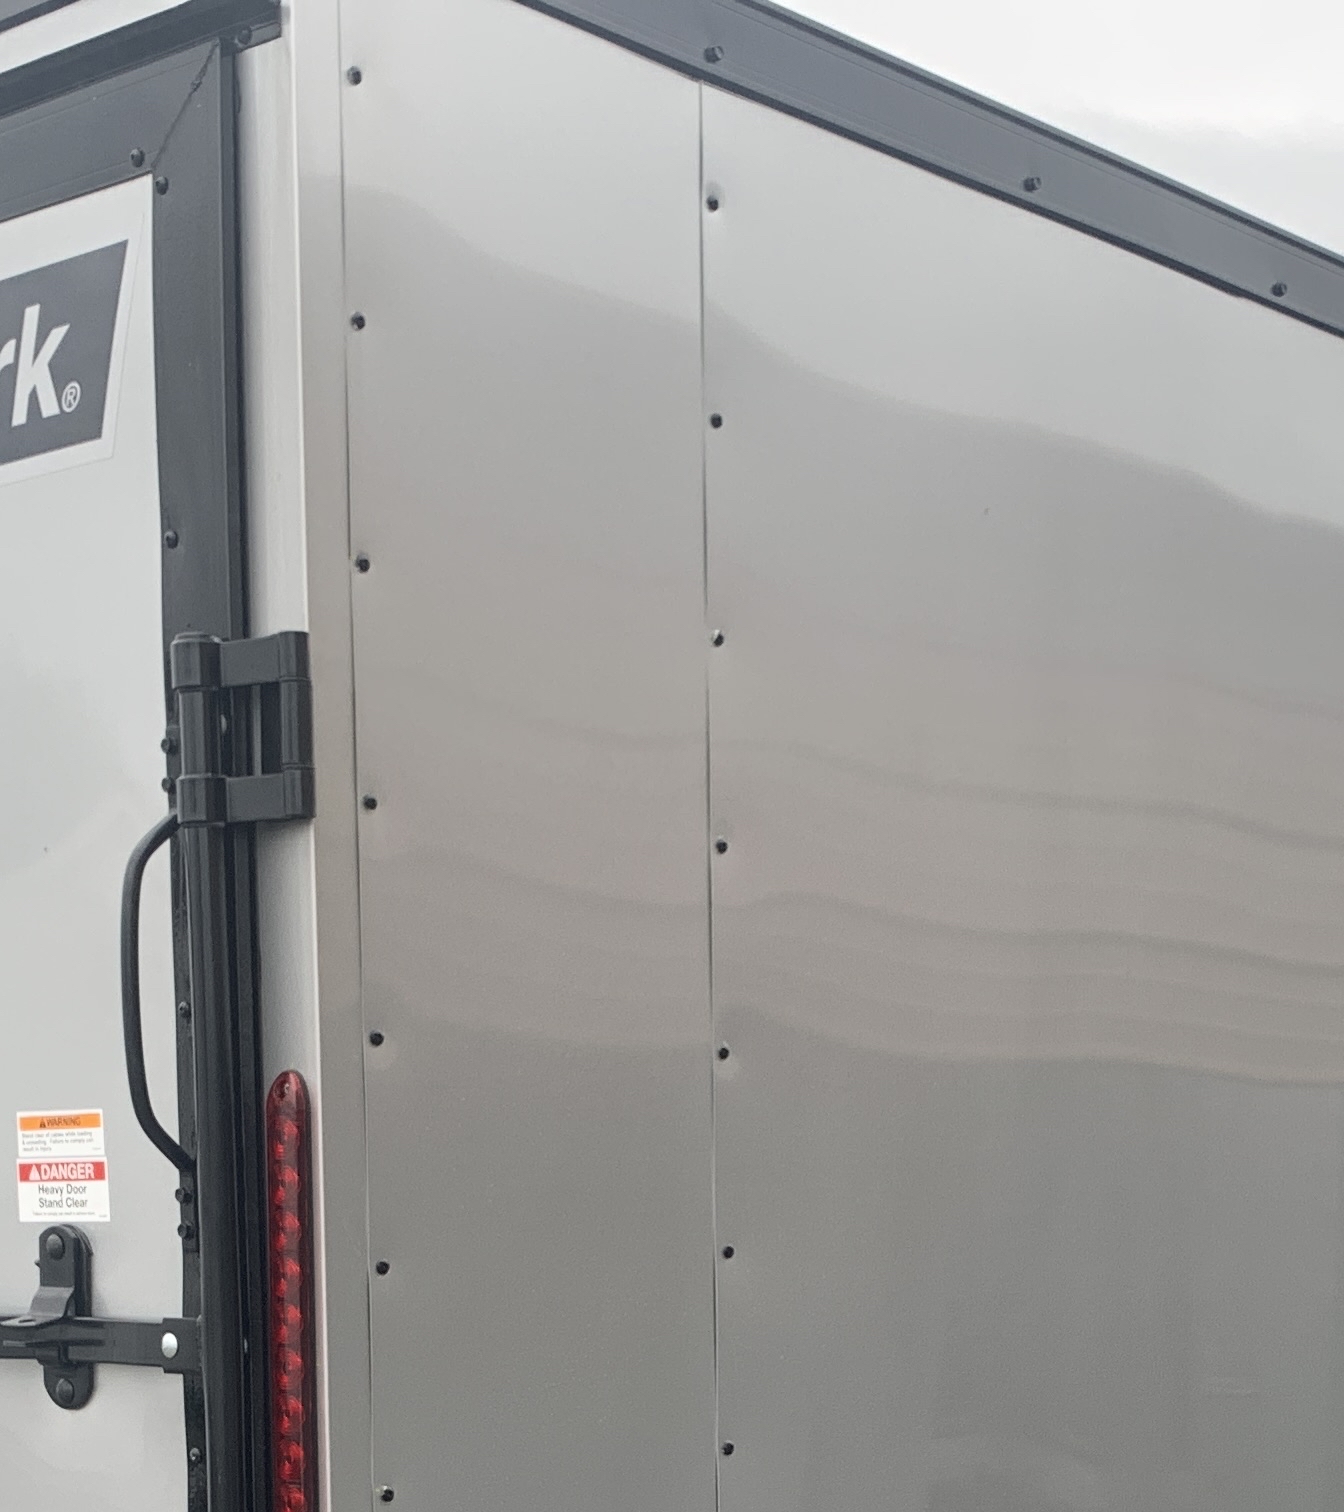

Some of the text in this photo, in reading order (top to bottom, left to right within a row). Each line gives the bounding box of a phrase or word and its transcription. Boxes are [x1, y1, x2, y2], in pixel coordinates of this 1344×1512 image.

[46, 1116, 81, 1127] WARNING
[40, 1163, 95, 1180] DANGER
[38, 1183, 87, 1196] Heavy Door
[38, 1197, 88, 1208] Stand Clear
